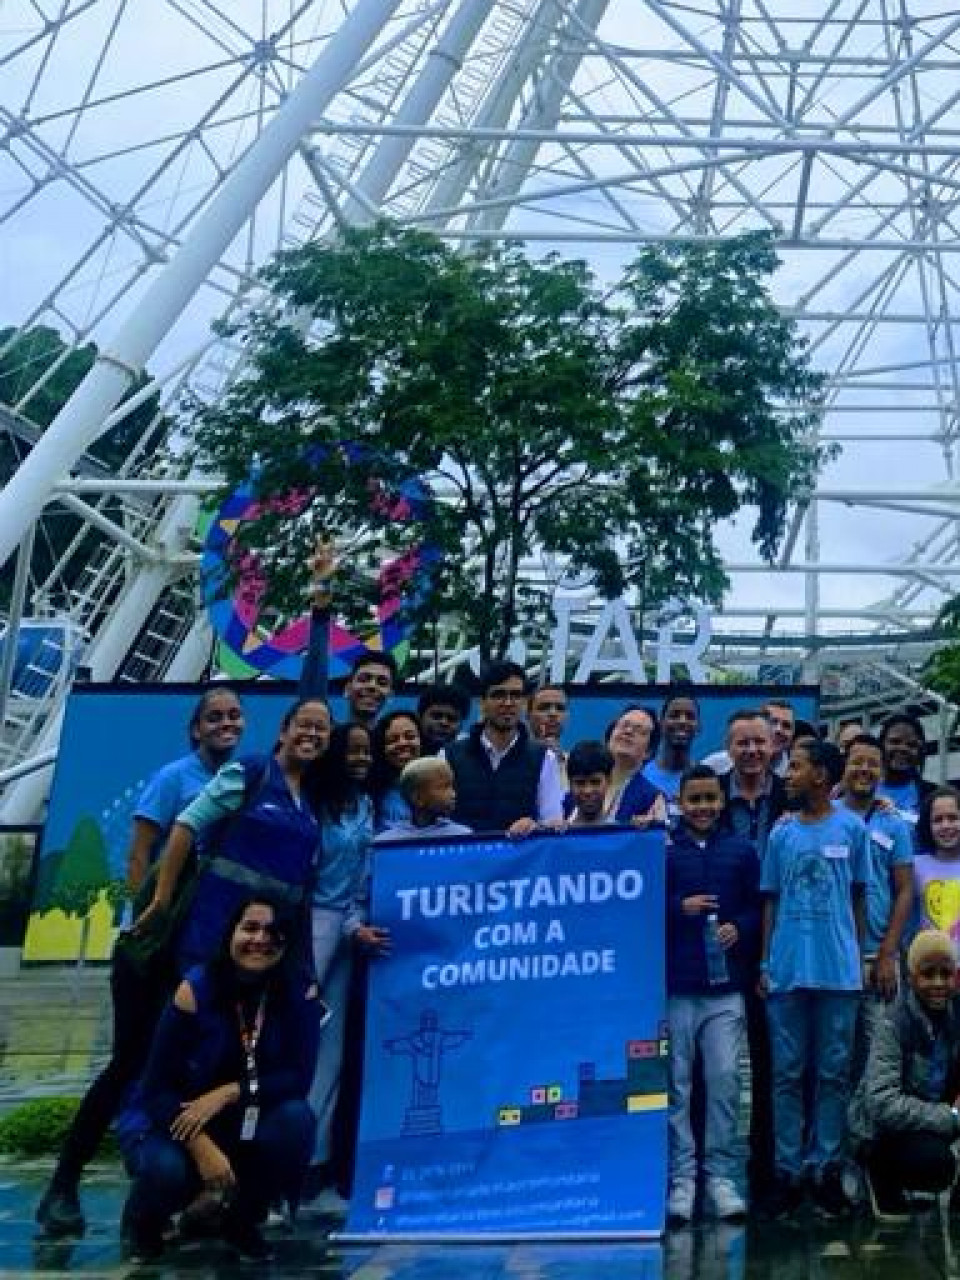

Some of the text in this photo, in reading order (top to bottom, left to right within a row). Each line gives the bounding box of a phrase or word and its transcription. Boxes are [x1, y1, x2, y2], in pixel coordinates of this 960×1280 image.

[397, 869, 643, 920] TURISTANDO
[474, 920, 565, 949] COM A
[421, 949, 616, 989] COMUNIDADE
